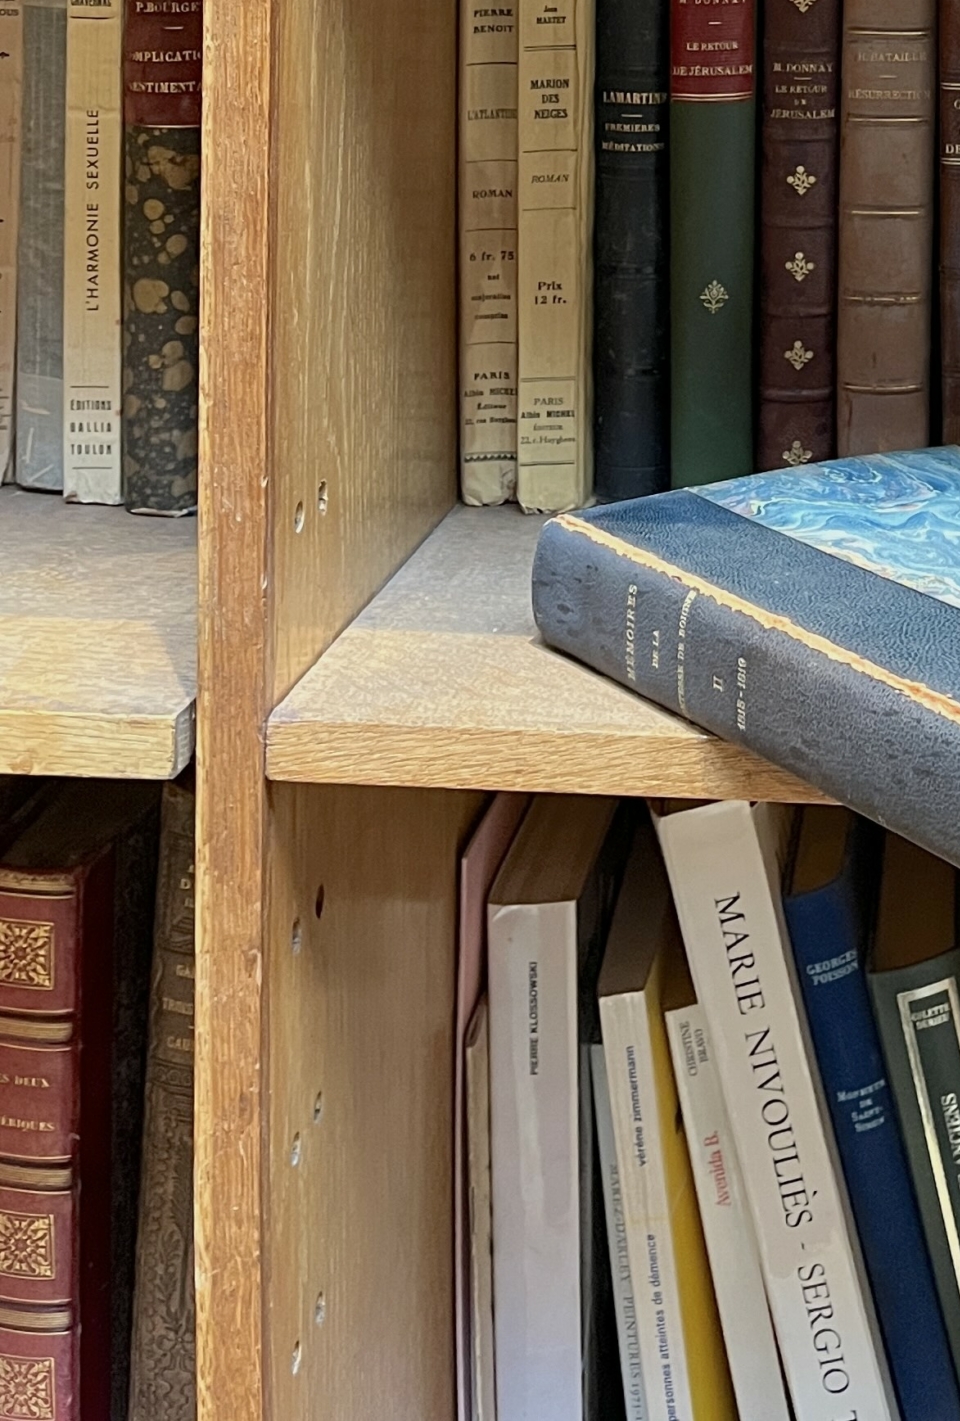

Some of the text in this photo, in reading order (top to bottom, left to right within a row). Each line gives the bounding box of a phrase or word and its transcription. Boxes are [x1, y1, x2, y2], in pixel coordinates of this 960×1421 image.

[473, 9, 513, 18] PIERRE
[473, 24, 514, 34] BENOIT
[686, 41, 739, 51] LE RETOUR
[673, 64, 753, 76] DE JÉRUSALEM
[530, 79, 570, 90] MARION
[775, 85, 828, 94] LE RETOUR
[541, 94, 560, 104] DES
[603, 91, 667, 106] LAMARTINE
[534, 109, 568, 119] NEIGES
[531, 174, 569, 184] ROMAN
[472, 189, 513, 200] ROMAN
[85, 109, 100, 311] L'HARMONIE SEXUELLE
[537, 281, 563, 291] Prix
[534, 294, 567, 305] 12 fr.
[474, 371, 510, 381] PARIS
[533, 397, 564, 406] PARIS
[806, 947, 857, 975] GEORGES
[812, 960, 858, 986] POISSON
[528, 961, 538, 1034] KLOSSOWSKI
[679, 1020, 698, 1077] CHRISTINE
[15, 1075, 50, 1088] DEUX
[714, 891, 765, 1017] MARIE
[744, 1025, 818, 1230] NIVOULIÈS
[797, 1263, 850, 1396] SERGIO
[704, 1130, 732, 1207] Avenida B.
[646, 1233, 664, 1287] démence
[651, 1290, 663, 1306] de
[622, 1296, 644, 1380] PEINTURES
[651, 1308, 670, 1360] atteintes
